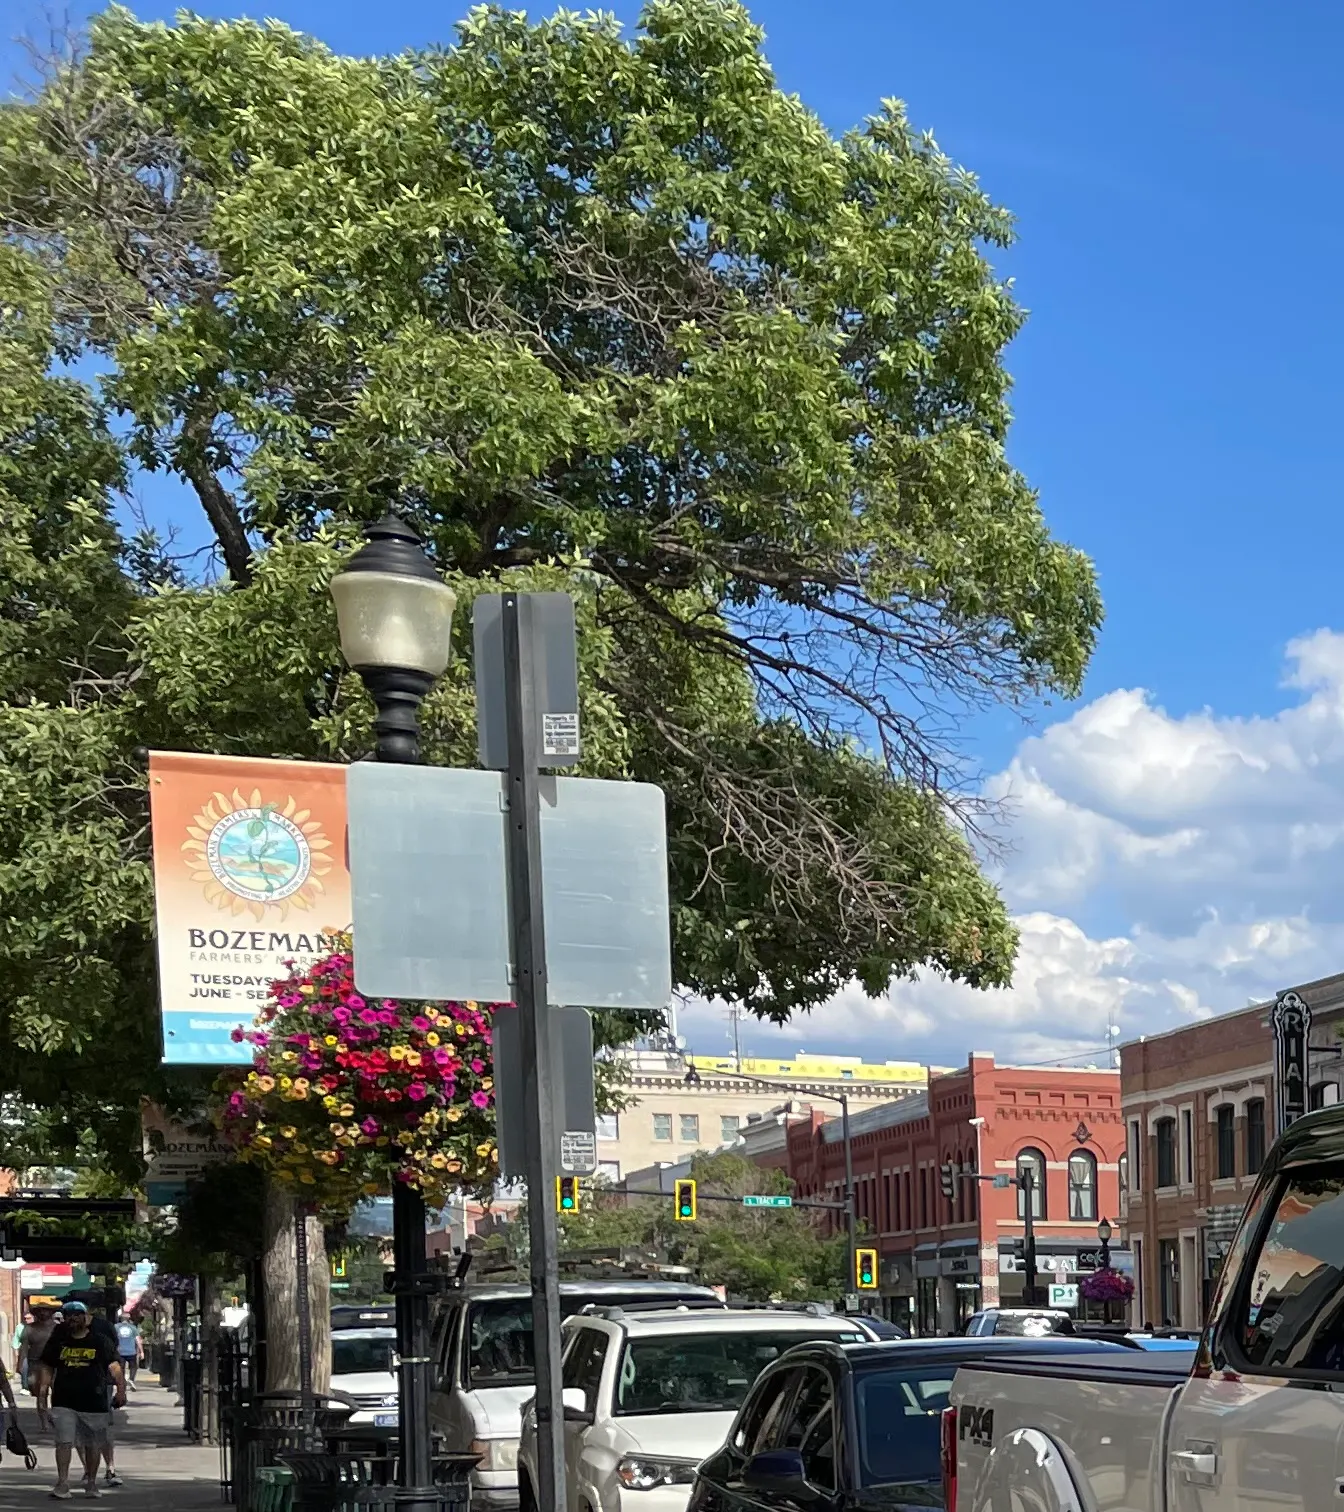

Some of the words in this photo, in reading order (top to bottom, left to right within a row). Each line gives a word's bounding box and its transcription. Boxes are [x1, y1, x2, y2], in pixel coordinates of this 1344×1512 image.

[188, 928, 335, 953] BOZEMAN
[190, 973, 274, 986] TUESDAYS
[189, 988, 231, 999] JUNE
[1053, 1288, 1065, 1303] P
[960, 1405, 994, 1441] FX4
